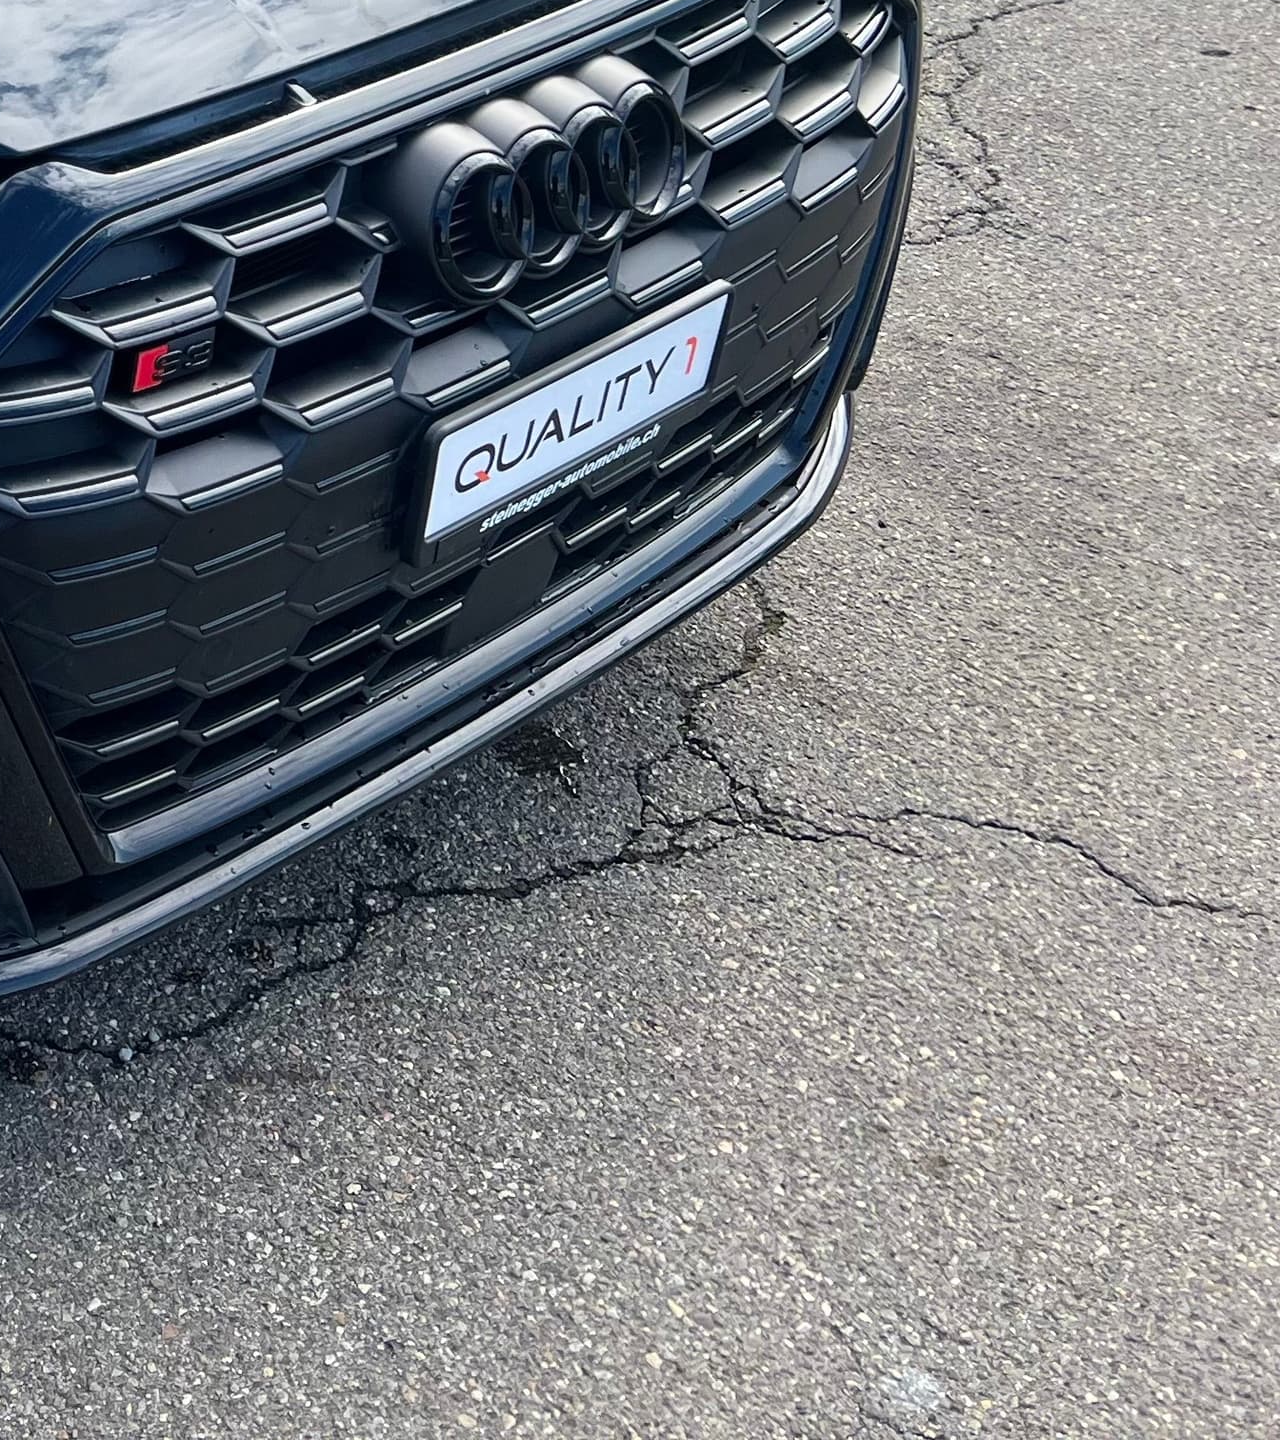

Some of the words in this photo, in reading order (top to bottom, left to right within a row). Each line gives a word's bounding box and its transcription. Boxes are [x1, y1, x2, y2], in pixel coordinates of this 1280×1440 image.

[454, 346, 676, 493] QUALITY
[685, 336, 698, 375] 1
[479, 423, 661, 533] steinegger-automobile.ch
